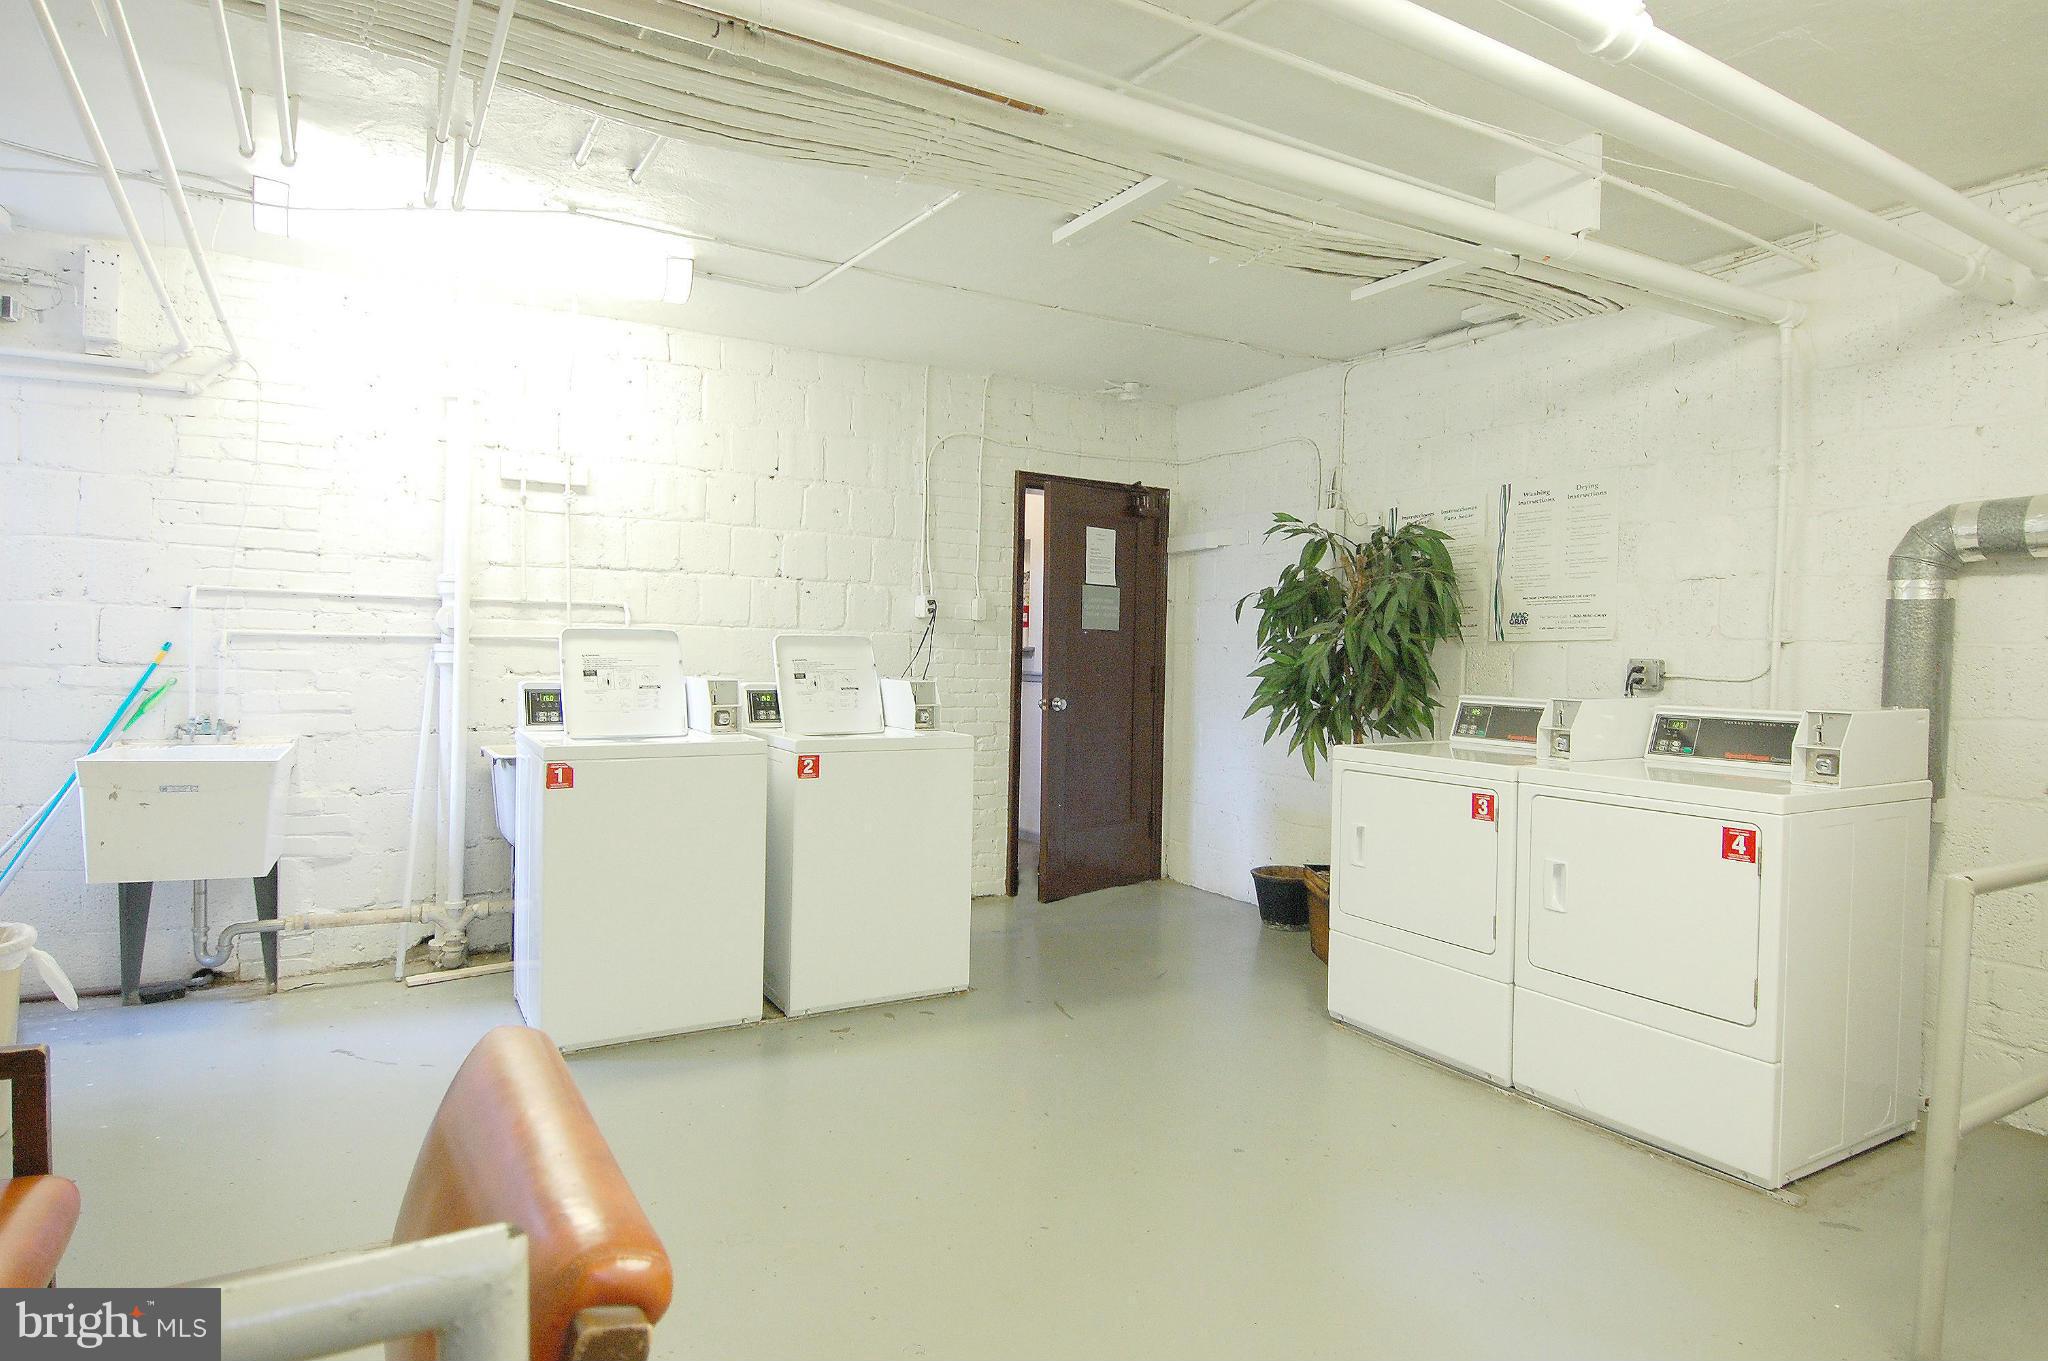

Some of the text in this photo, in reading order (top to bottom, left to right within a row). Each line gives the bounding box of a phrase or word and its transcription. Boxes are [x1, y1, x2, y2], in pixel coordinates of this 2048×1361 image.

[1523, 489, 1551, 497] Washing
[1576, 482, 1599, 492] Drying
[1567, 490, 1607, 500] Instructions
[1518, 497, 1555, 506] Instructions
[803, 759, 814, 774] 2
[554, 767, 563, 783] 1
[1478, 799, 1488, 815] 3
[1731, 834, 1747, 855] 4
